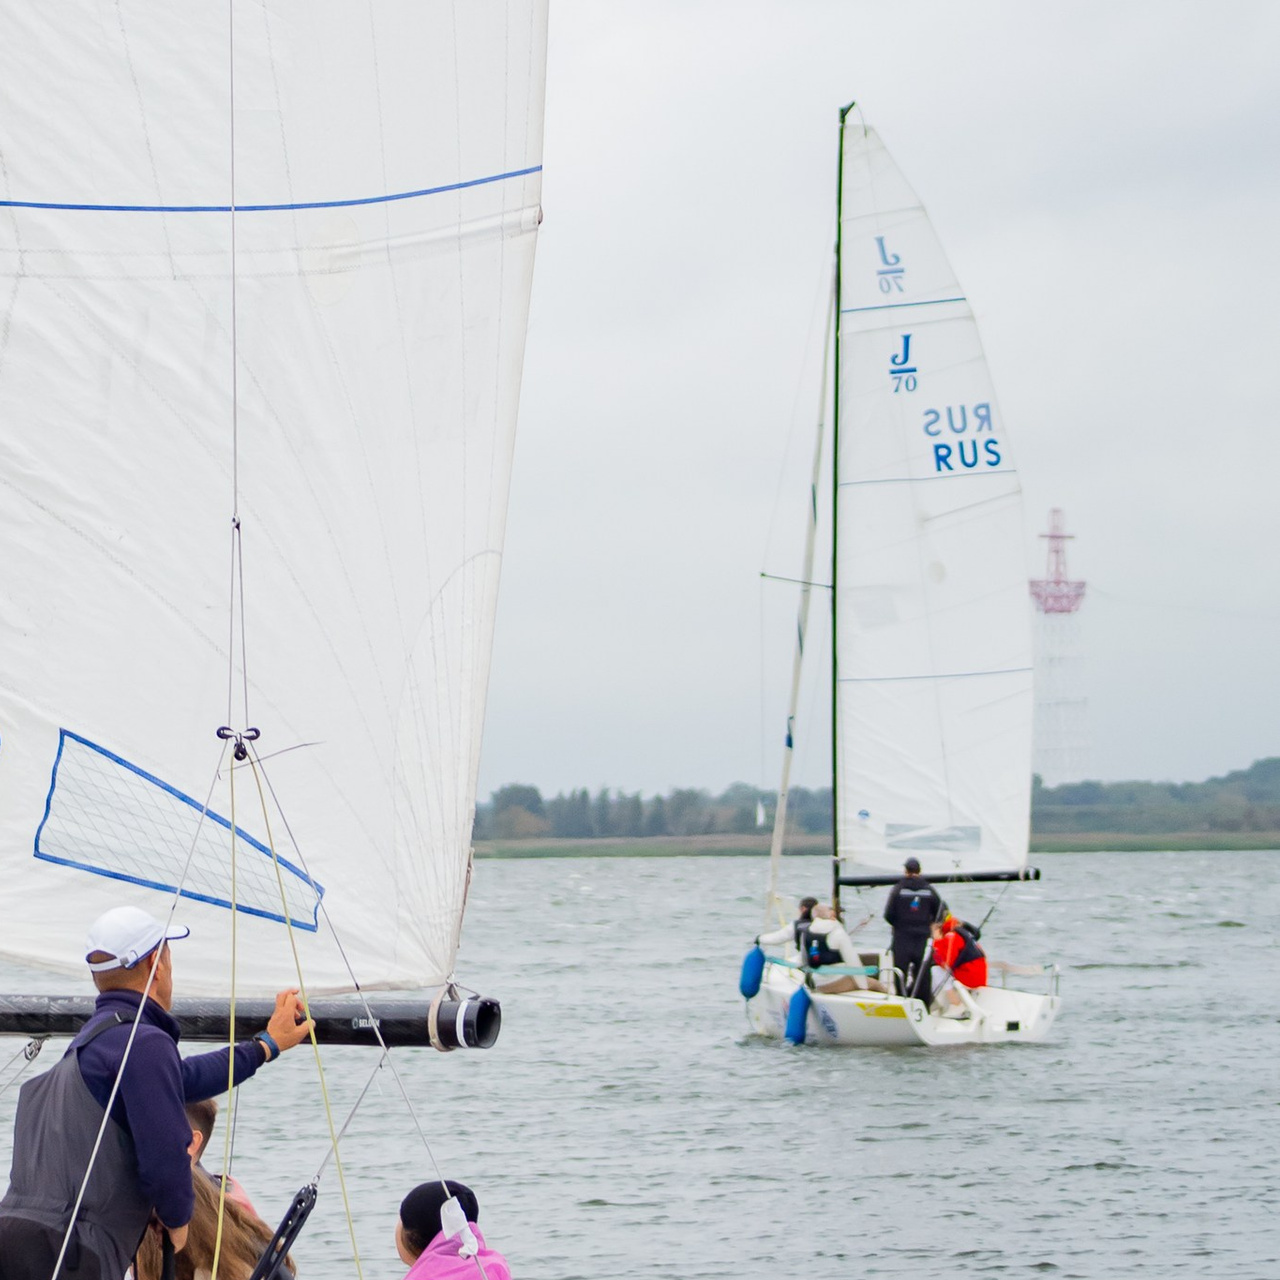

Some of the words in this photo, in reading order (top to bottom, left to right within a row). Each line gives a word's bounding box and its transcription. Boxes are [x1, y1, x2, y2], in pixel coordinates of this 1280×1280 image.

[890, 333, 912, 366] J
[892, 375, 917, 393] 70
[933, 438, 1001, 472] RUS
[915, 1008, 923, 1022] 3
